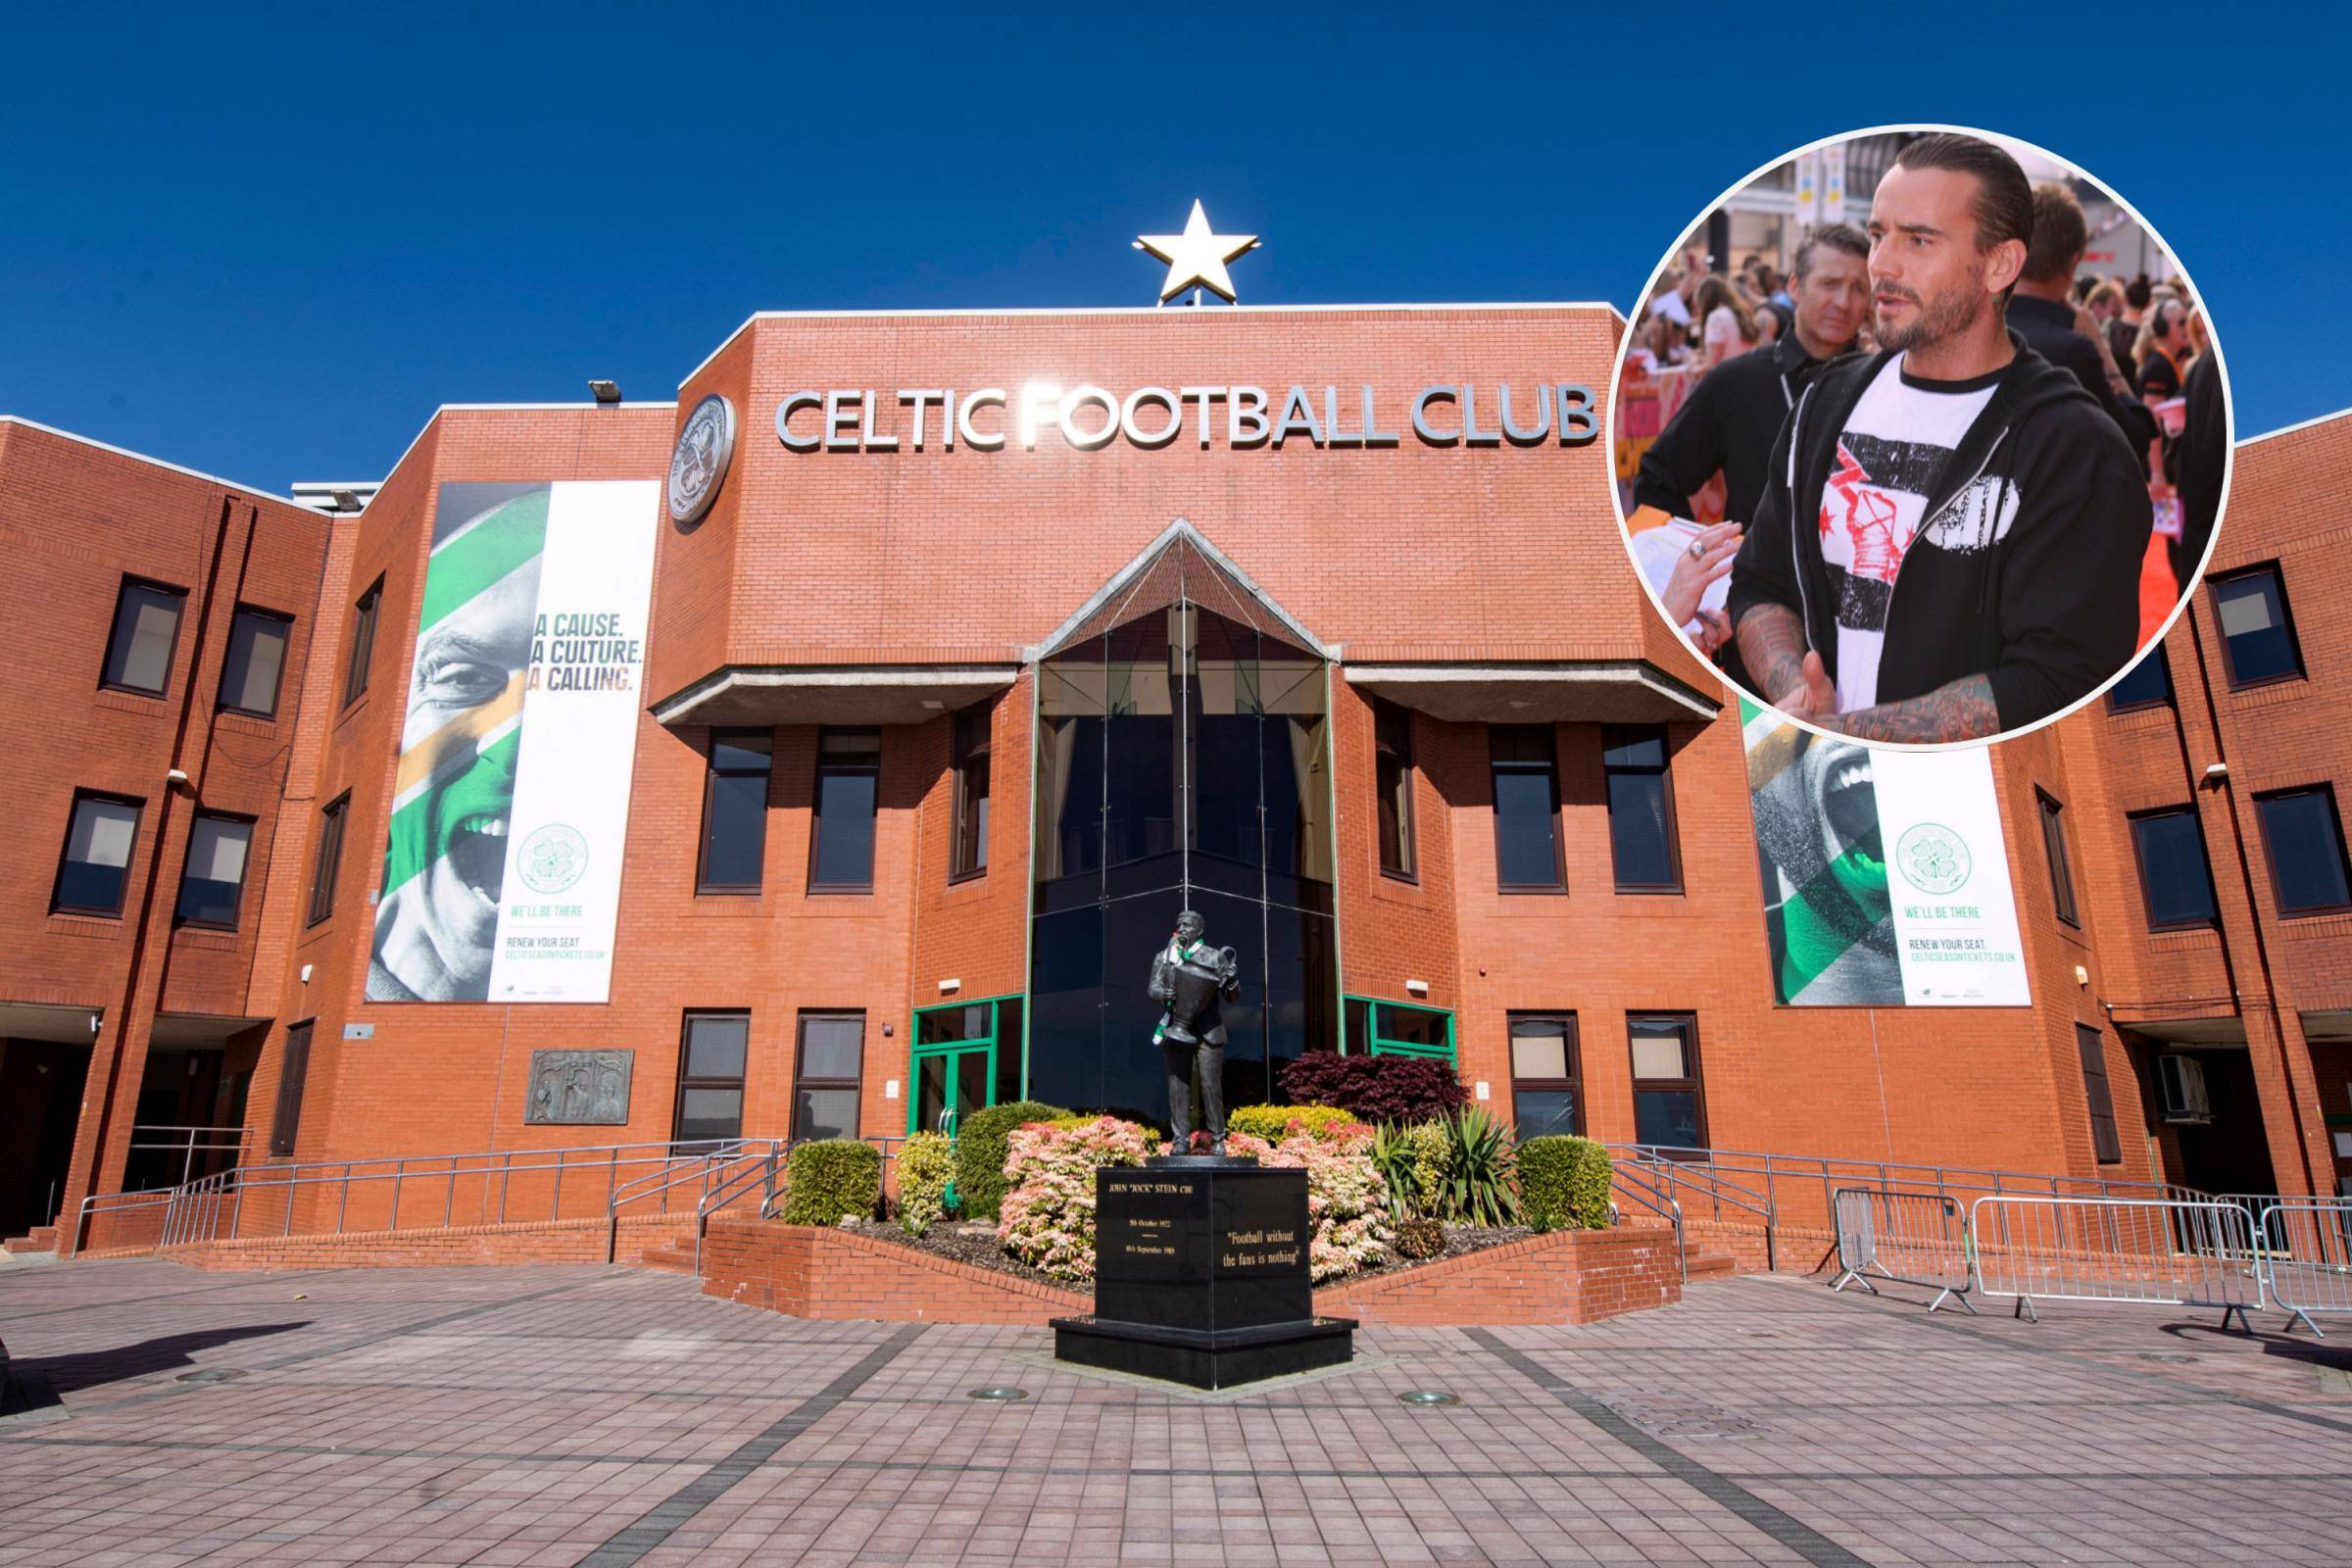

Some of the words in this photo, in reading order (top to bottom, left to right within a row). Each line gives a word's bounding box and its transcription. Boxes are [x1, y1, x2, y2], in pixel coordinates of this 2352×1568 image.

[775, 388, 1006, 452] CELTIC
[1022, 385, 1399, 451] FOOTBALL
[1412, 384, 1599, 448] CLUB
[534, 613, 547, 637] A
[554, 613, 623, 637] CAUSE.
[530, 640, 544, 663] A
[551, 640, 642, 663] CULTURE.
[527, 667, 540, 691] A
[547, 667, 633, 691] CALLING.
[511, 906, 538, 917] WE'LL
[540, 906, 551, 917] BE
[555, 906, 582, 917] THERE
[1904, 906, 1934, 918] WE'LL
[1936, 906, 1947, 918] BE
[1950, 906, 1981, 918] THERE
[507, 937, 534, 948] RENEW
[537, 937, 558, 948] YOUR
[1909, 939, 1938, 950] RENEW
[1941, 939, 1963, 950] YOUR
[1108, 1184, 1127, 1193] JOHN
[1154, 1184, 1178, 1194] STEIN
[1227, 1230, 1263, 1245] "Football
[1266, 1229, 1294, 1244] without
[1223, 1253, 1236, 1267] the
[1239, 1252, 1255, 1266] fans
[1258, 1250, 1266, 1264] is
[1268, 1249, 1299, 1265] nothing"
